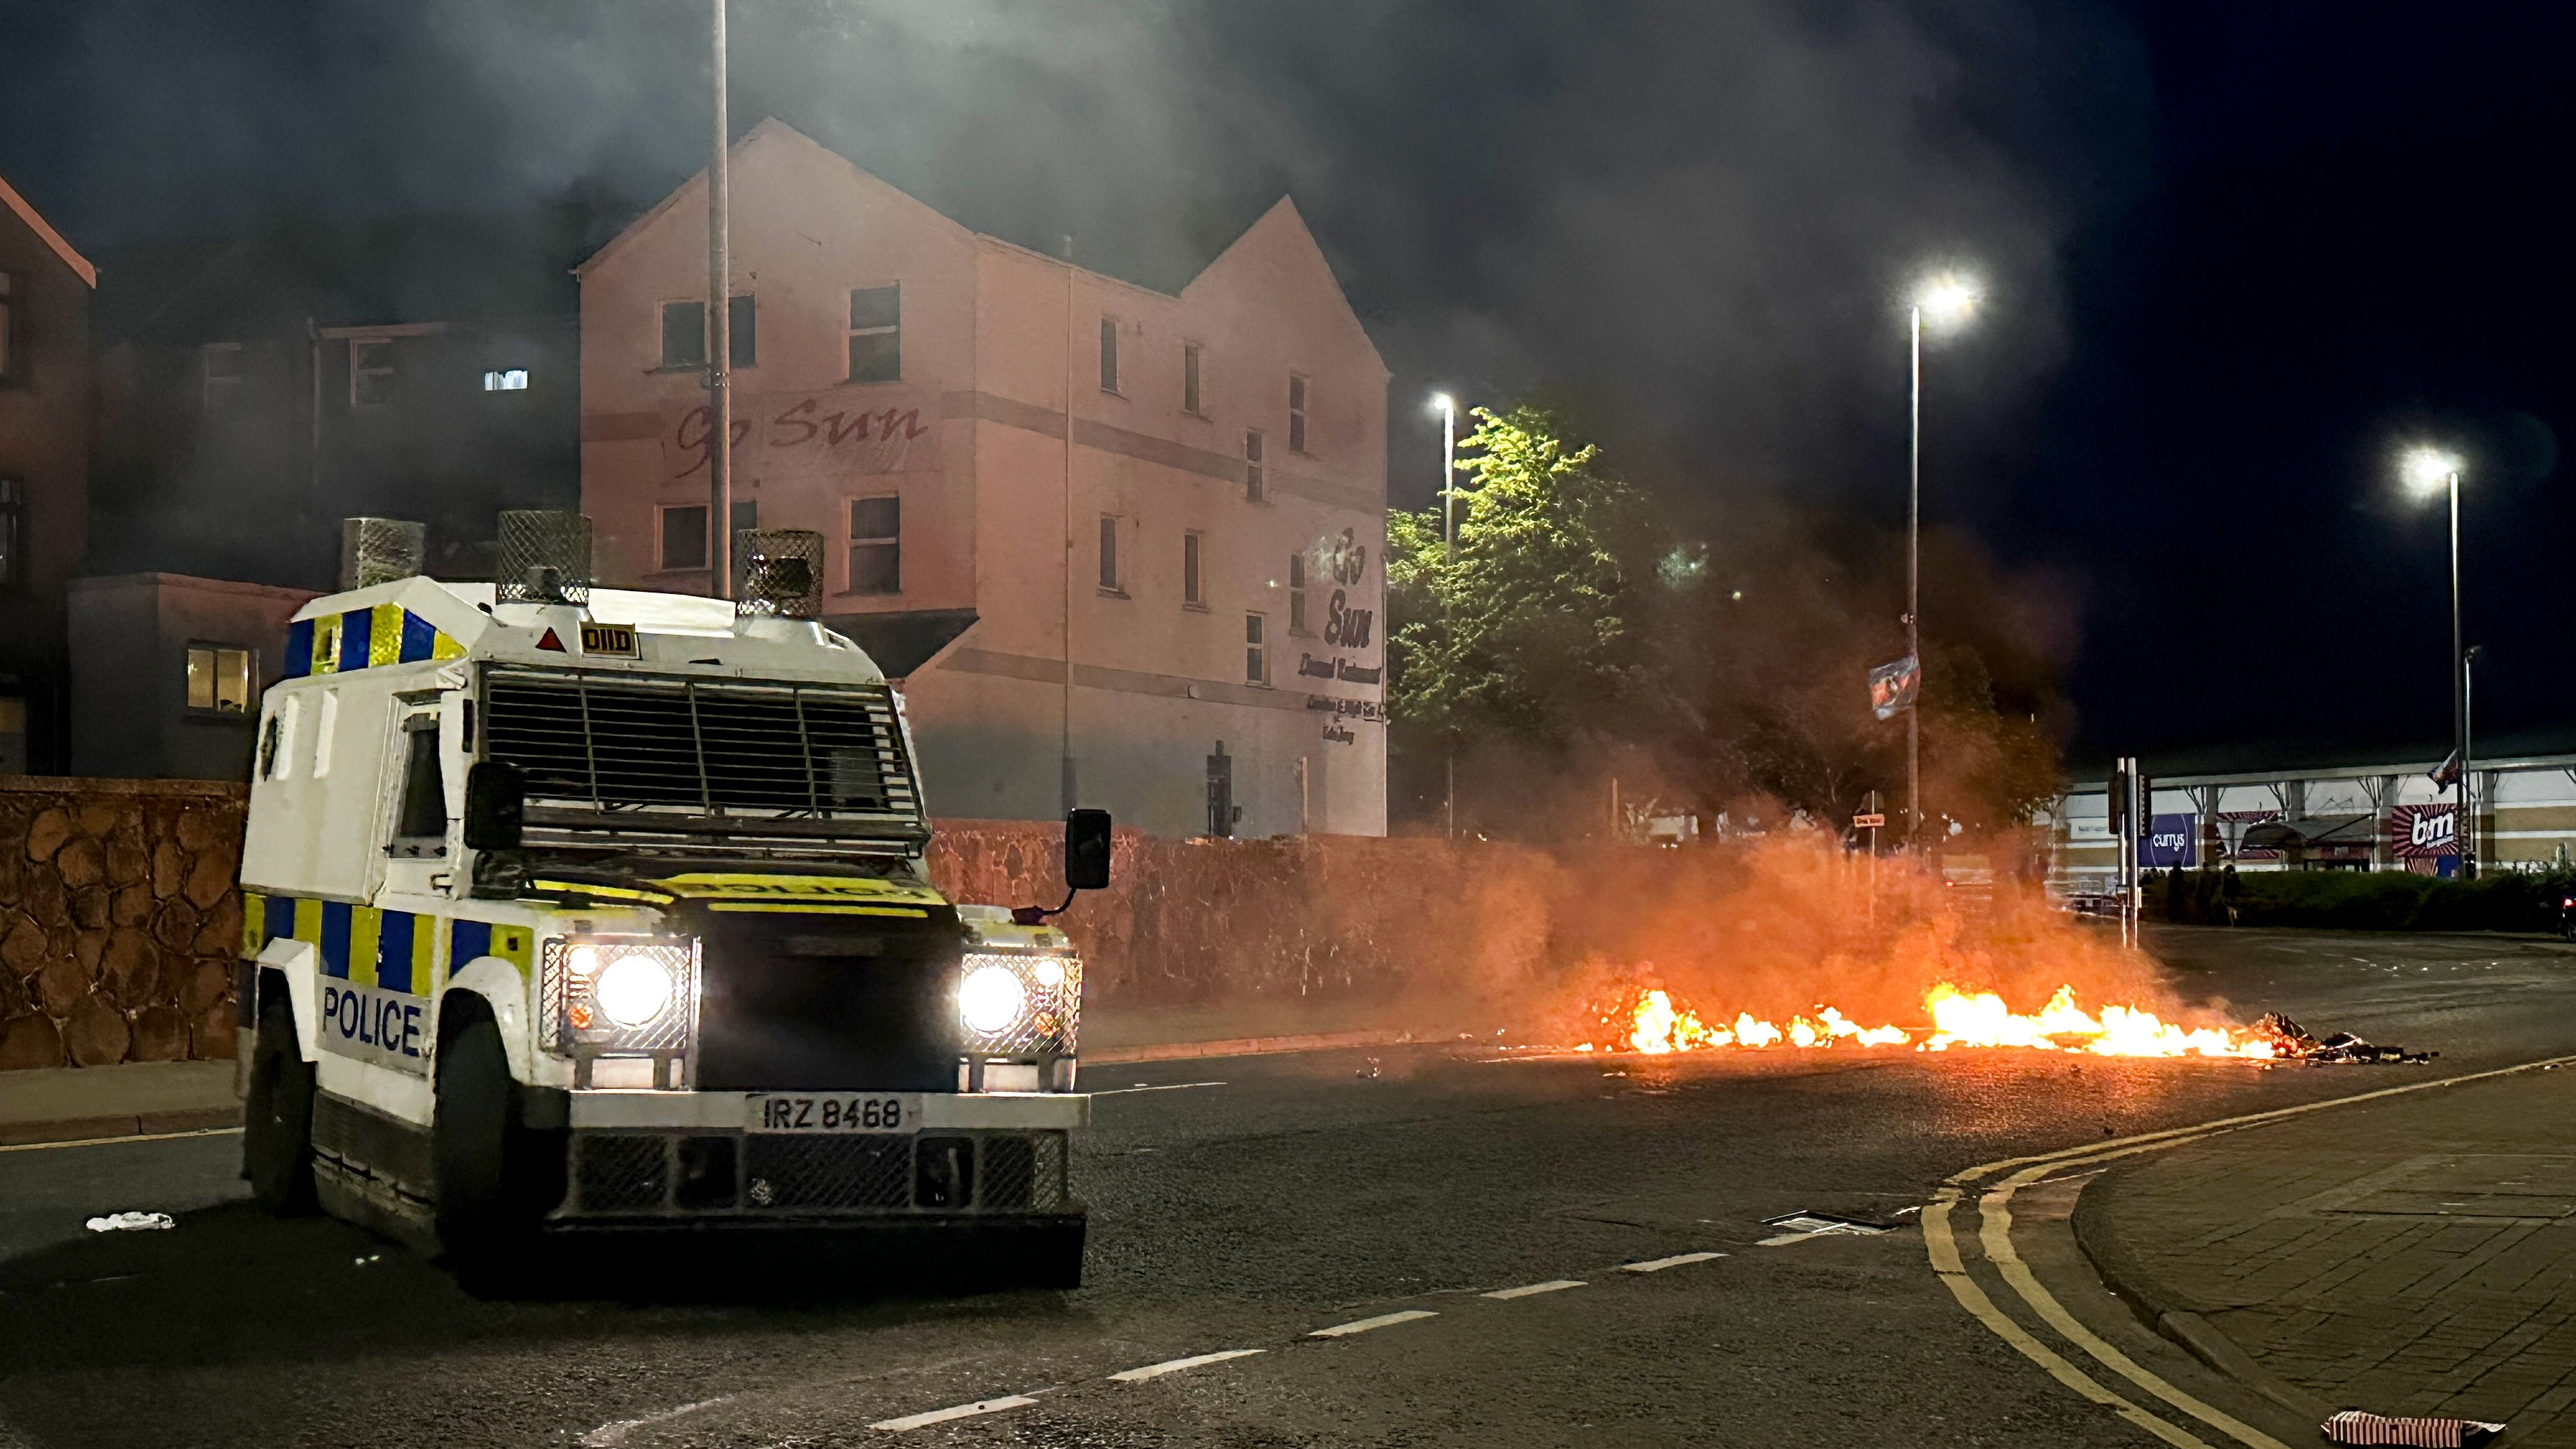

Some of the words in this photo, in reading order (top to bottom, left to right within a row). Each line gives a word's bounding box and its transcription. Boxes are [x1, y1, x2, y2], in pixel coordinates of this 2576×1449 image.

[771, 398, 928, 447] Sun
[1325, 589, 1372, 648] Sun
[323, 987, 422, 1058] POLICE
[764, 1099, 814, 1128] IRZ
[822, 1099, 900, 1128] 8468
